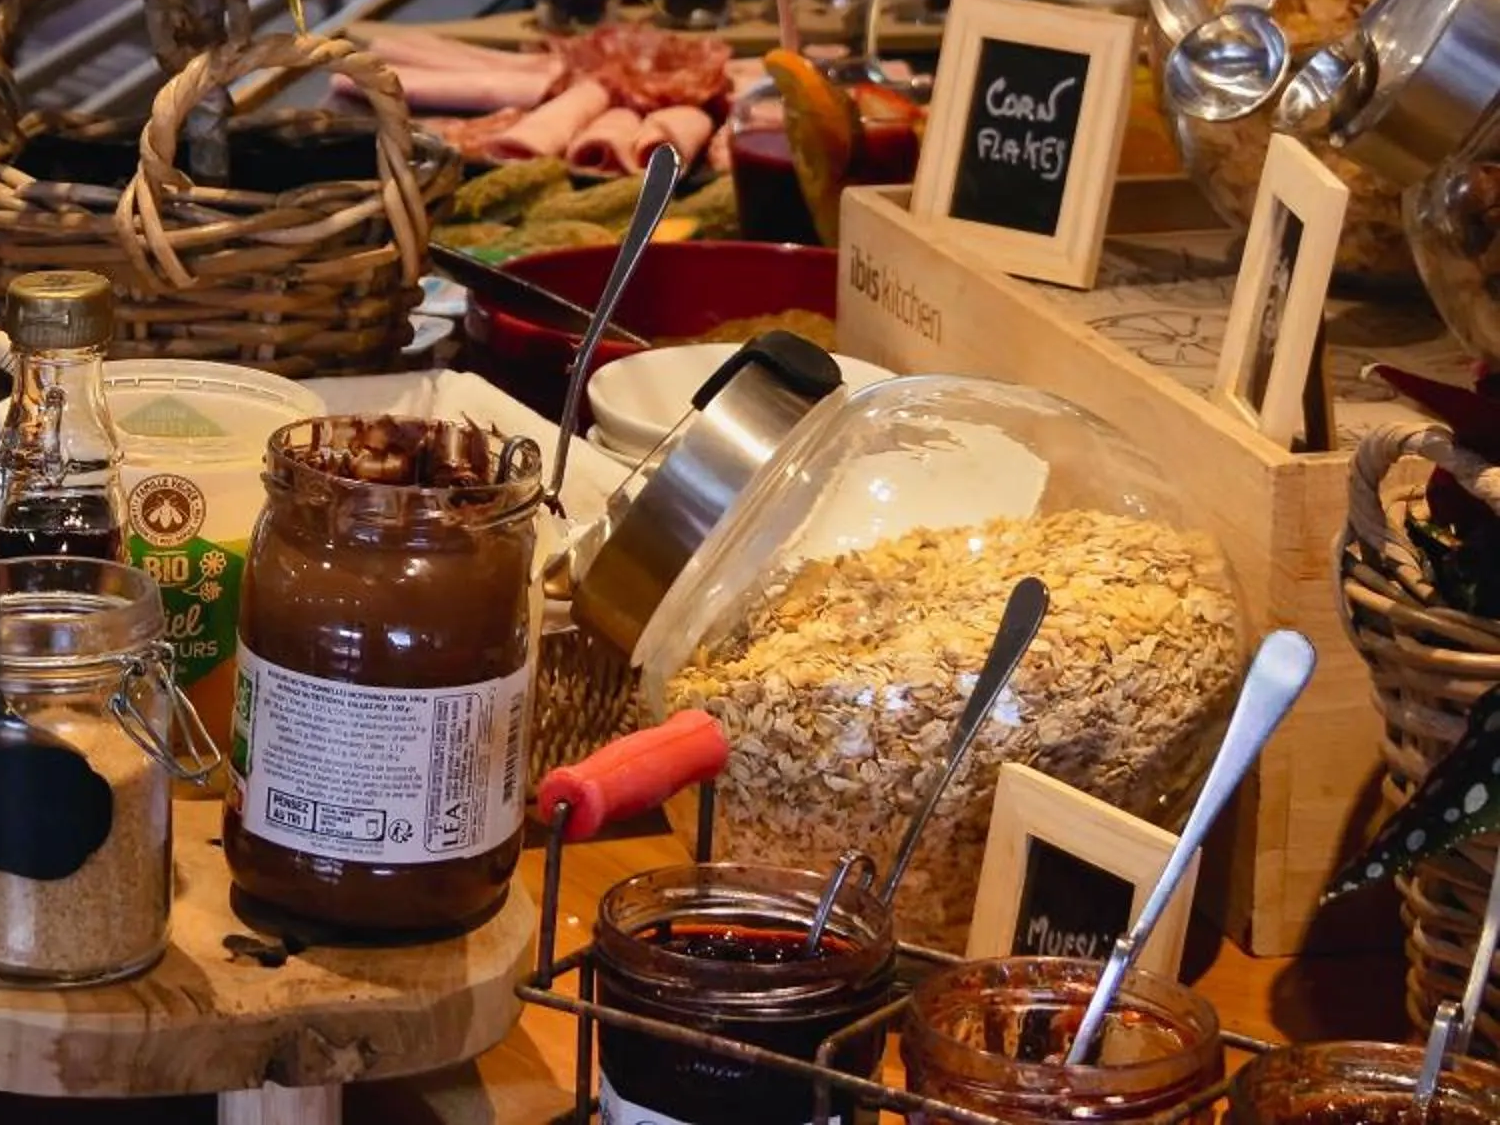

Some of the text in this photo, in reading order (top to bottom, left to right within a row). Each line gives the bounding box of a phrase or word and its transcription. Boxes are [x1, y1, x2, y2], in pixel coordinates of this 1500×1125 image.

[849, 243, 942, 347] ibis kitchen
[142, 556, 189, 582] BIO
